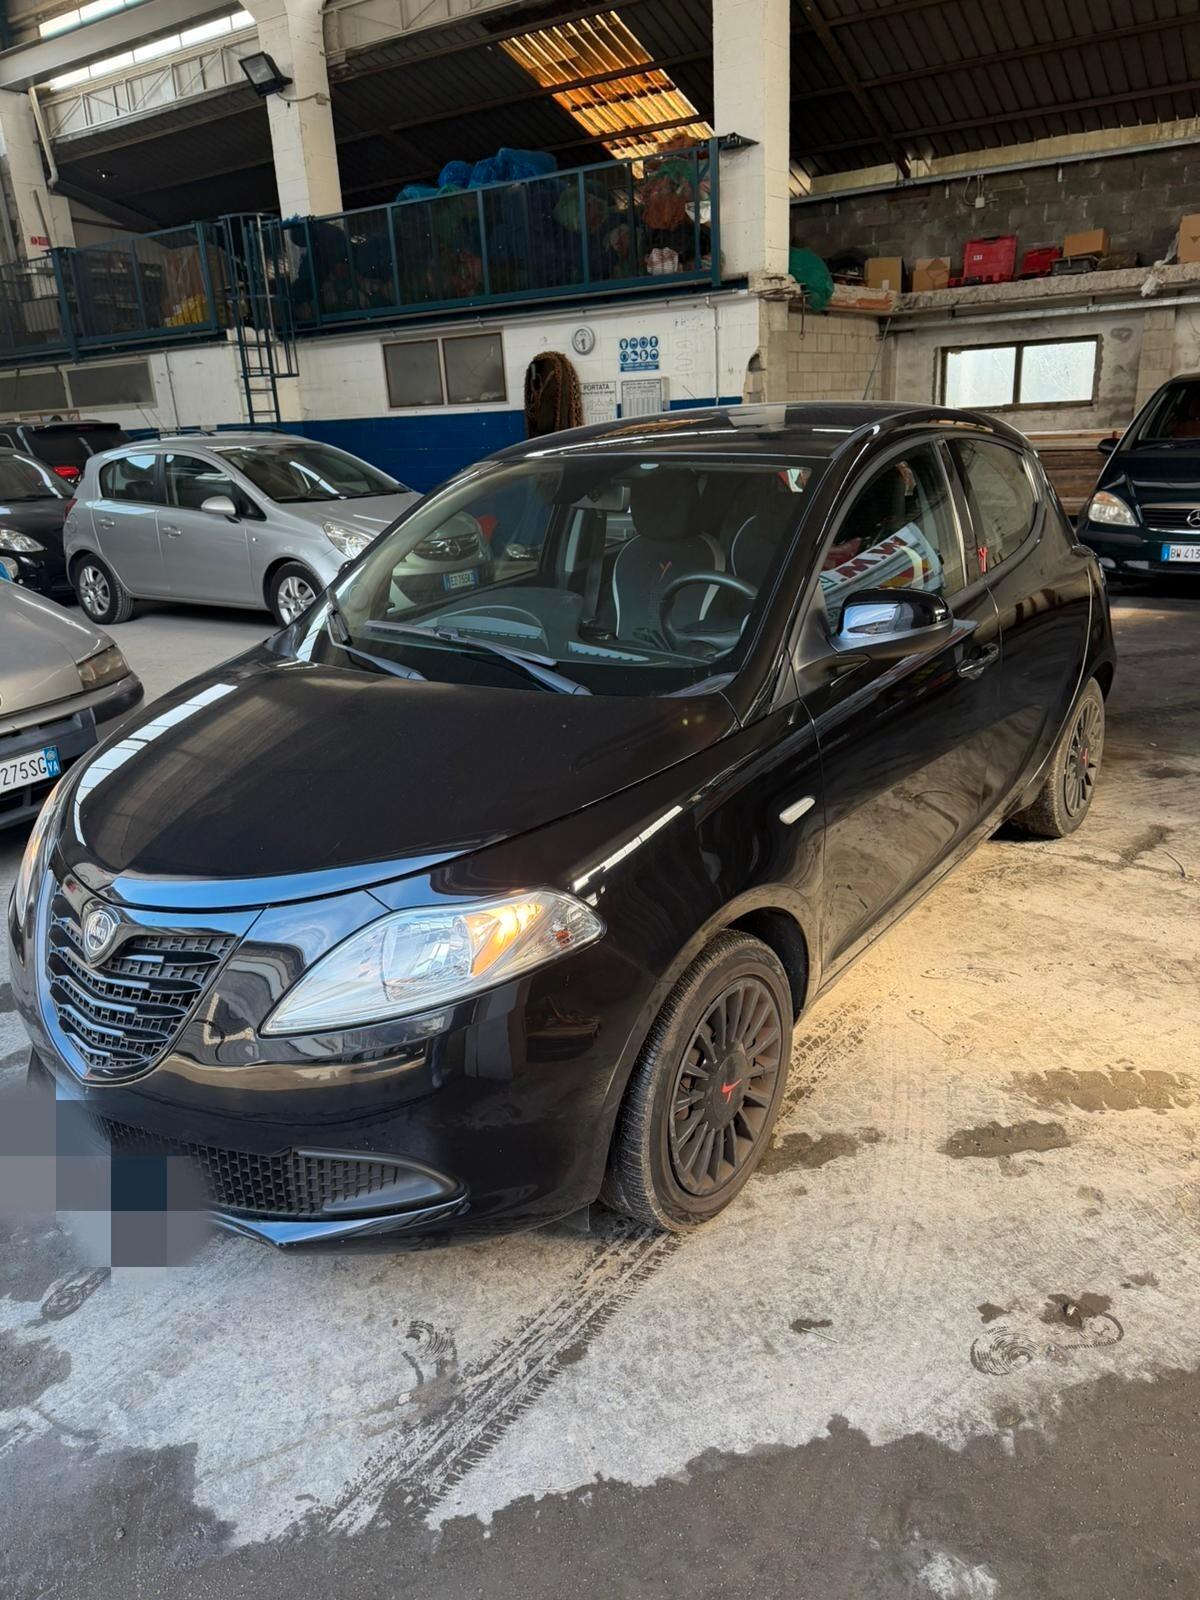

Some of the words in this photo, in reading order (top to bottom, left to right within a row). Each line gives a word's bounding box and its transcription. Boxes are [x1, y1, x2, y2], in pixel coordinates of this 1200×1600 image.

[583, 383, 610, 392] PORTATA
[0, 756, 47, 786] 275SG
[47, 760, 60, 771] VA
